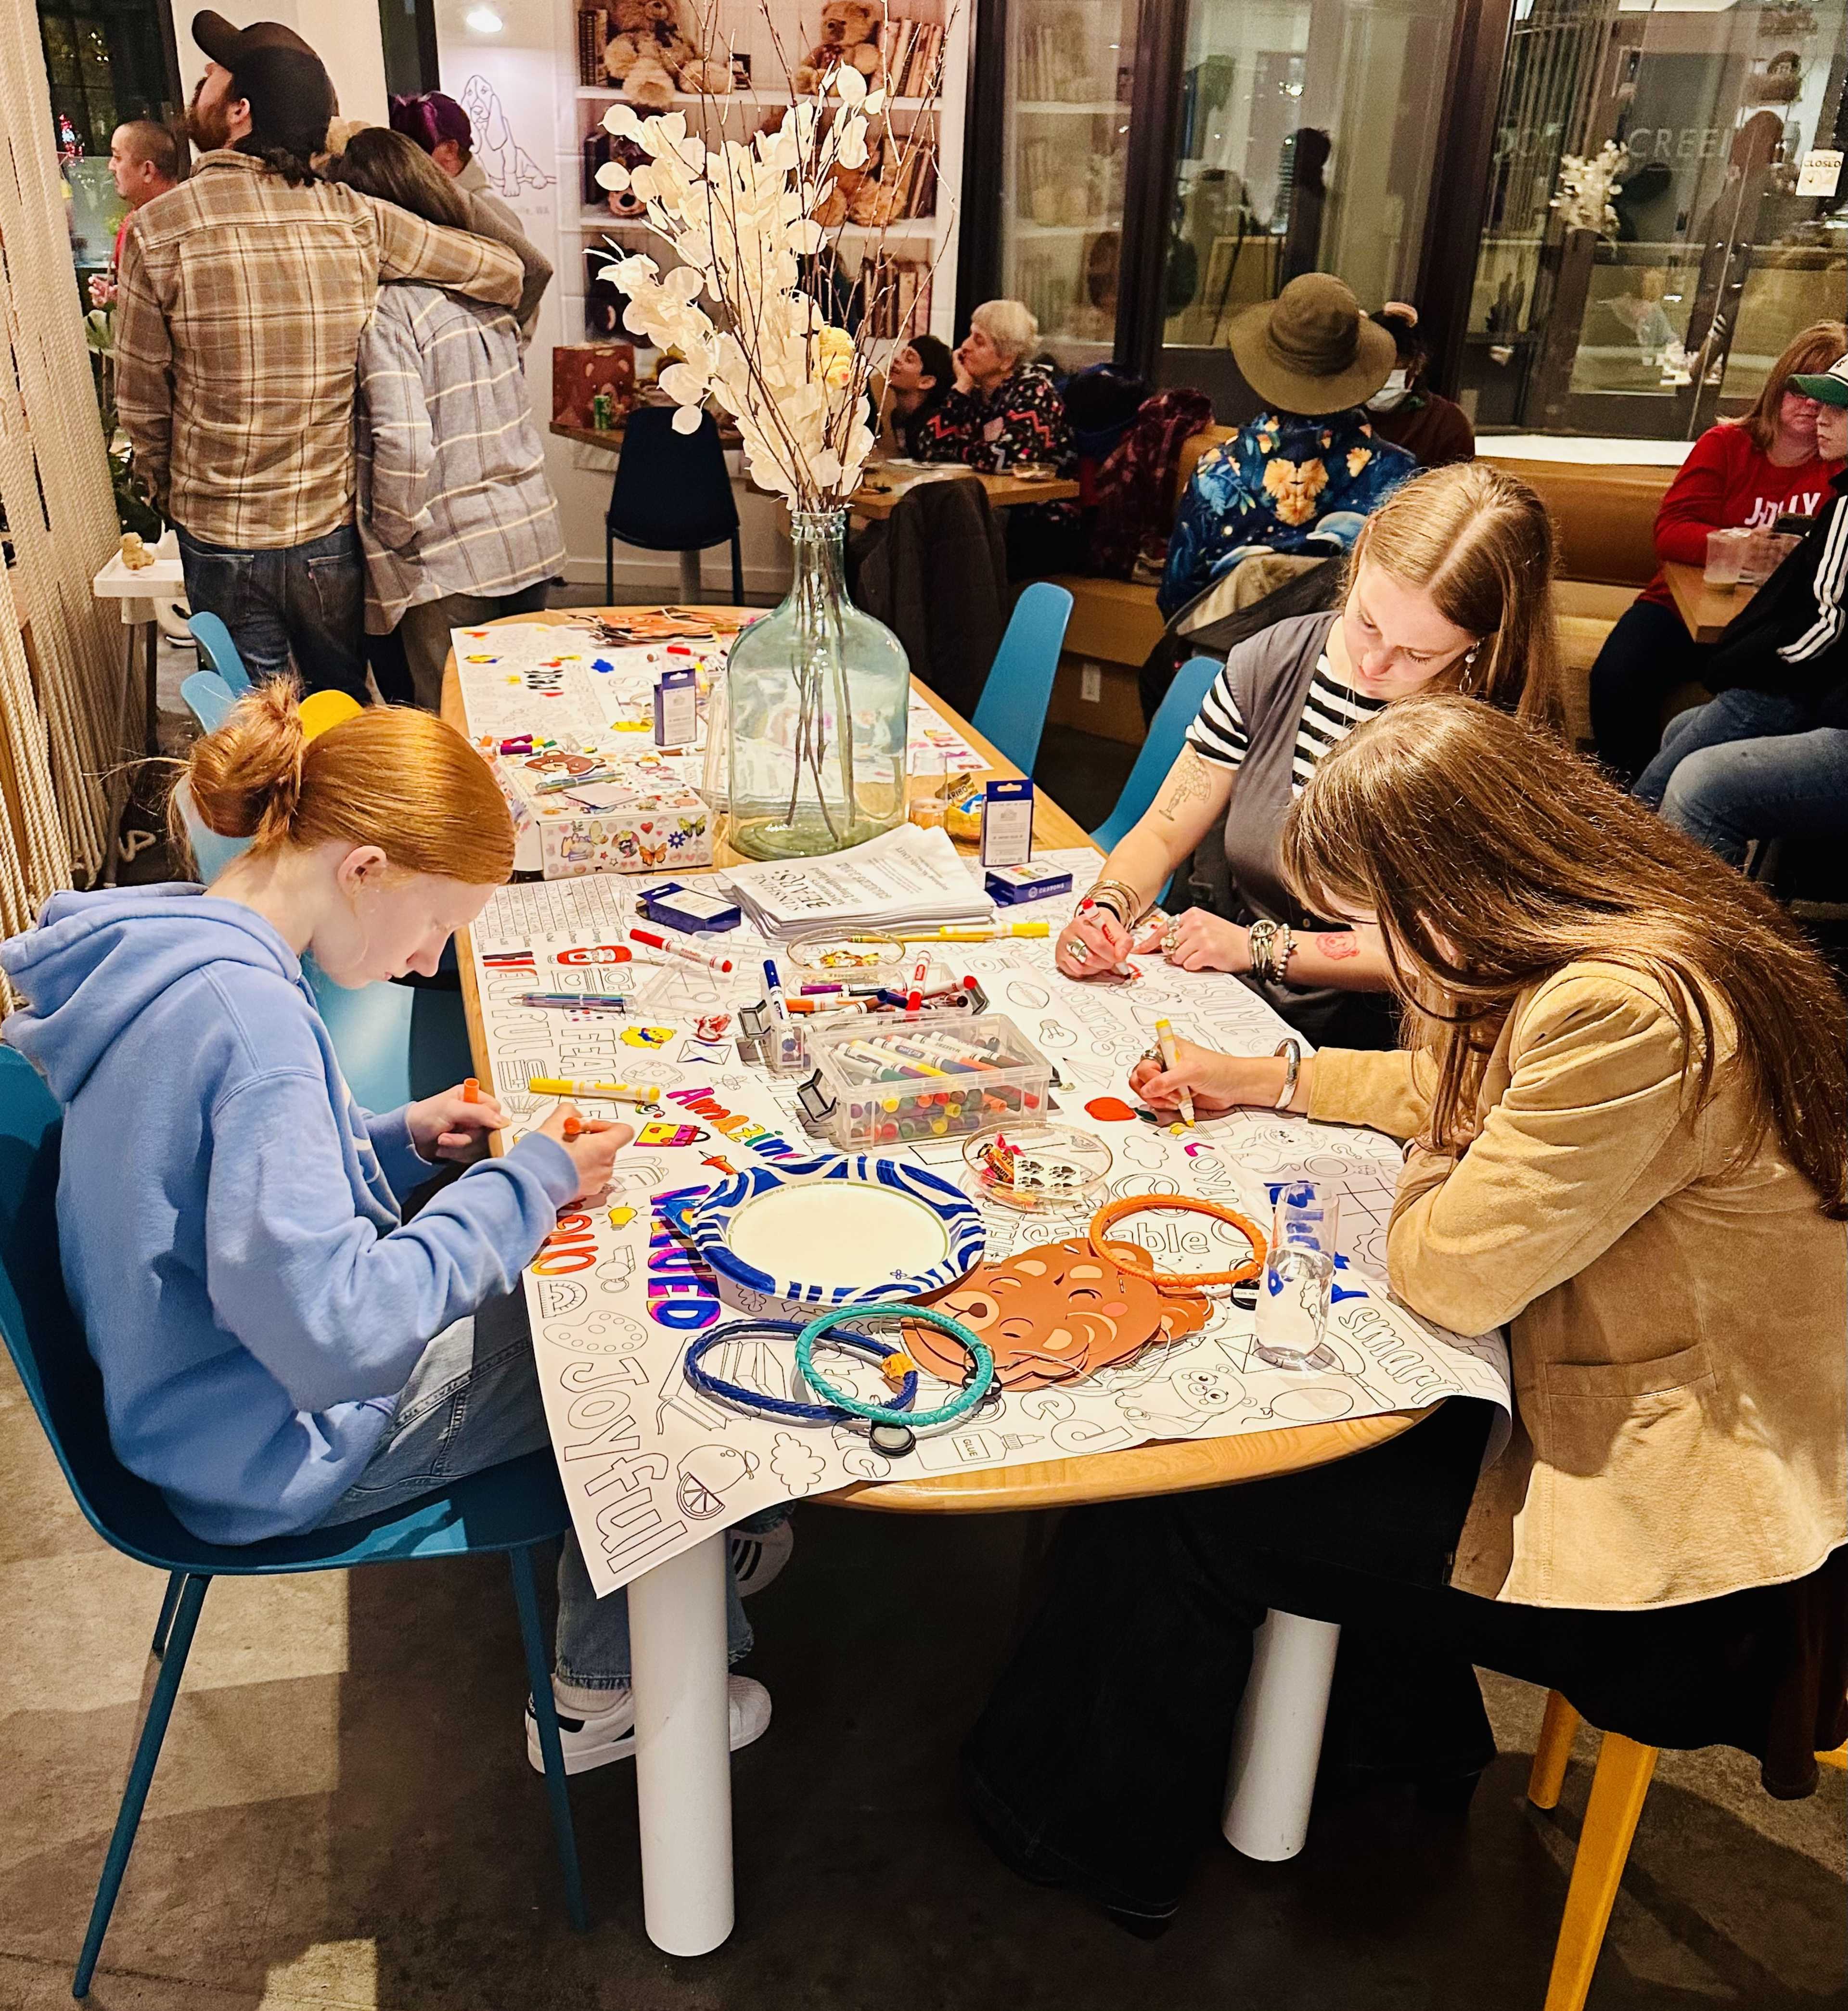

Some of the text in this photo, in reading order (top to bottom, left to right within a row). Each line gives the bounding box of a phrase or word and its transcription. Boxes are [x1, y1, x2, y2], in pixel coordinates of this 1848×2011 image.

[523, 669, 565, 690] rest
[751, 873, 802, 911] SUNSHINE
[771, 870, 832, 909] BEARS:
[808, 867, 854, 898] Empathyland
[811, 879, 846, 905] Adventures
[648, 1184, 722, 1330] VLUED
[1338, 1307, 1465, 1405] smart
[962, 1438, 979, 1457] GLUE
